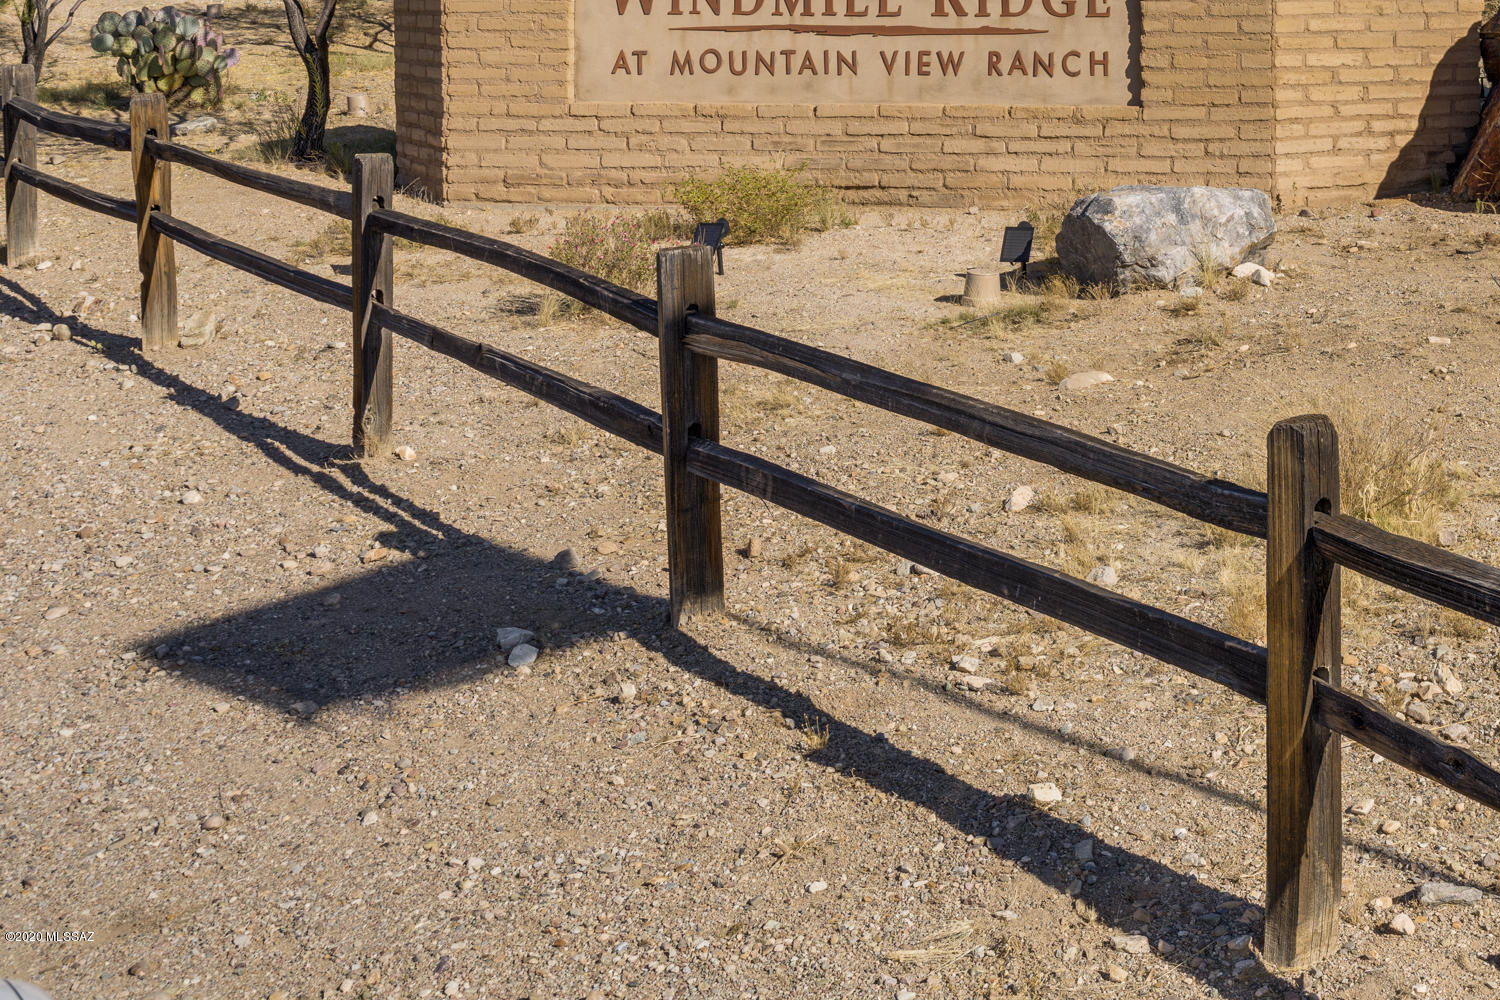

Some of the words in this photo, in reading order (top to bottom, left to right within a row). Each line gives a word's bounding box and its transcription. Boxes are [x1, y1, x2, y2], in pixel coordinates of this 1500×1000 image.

[611, 49, 648, 76] AT
[669, 48, 858, 77] MOUNTAIN
[879, 50, 965, 77] VIEW
[987, 49, 1110, 79] RANCH
